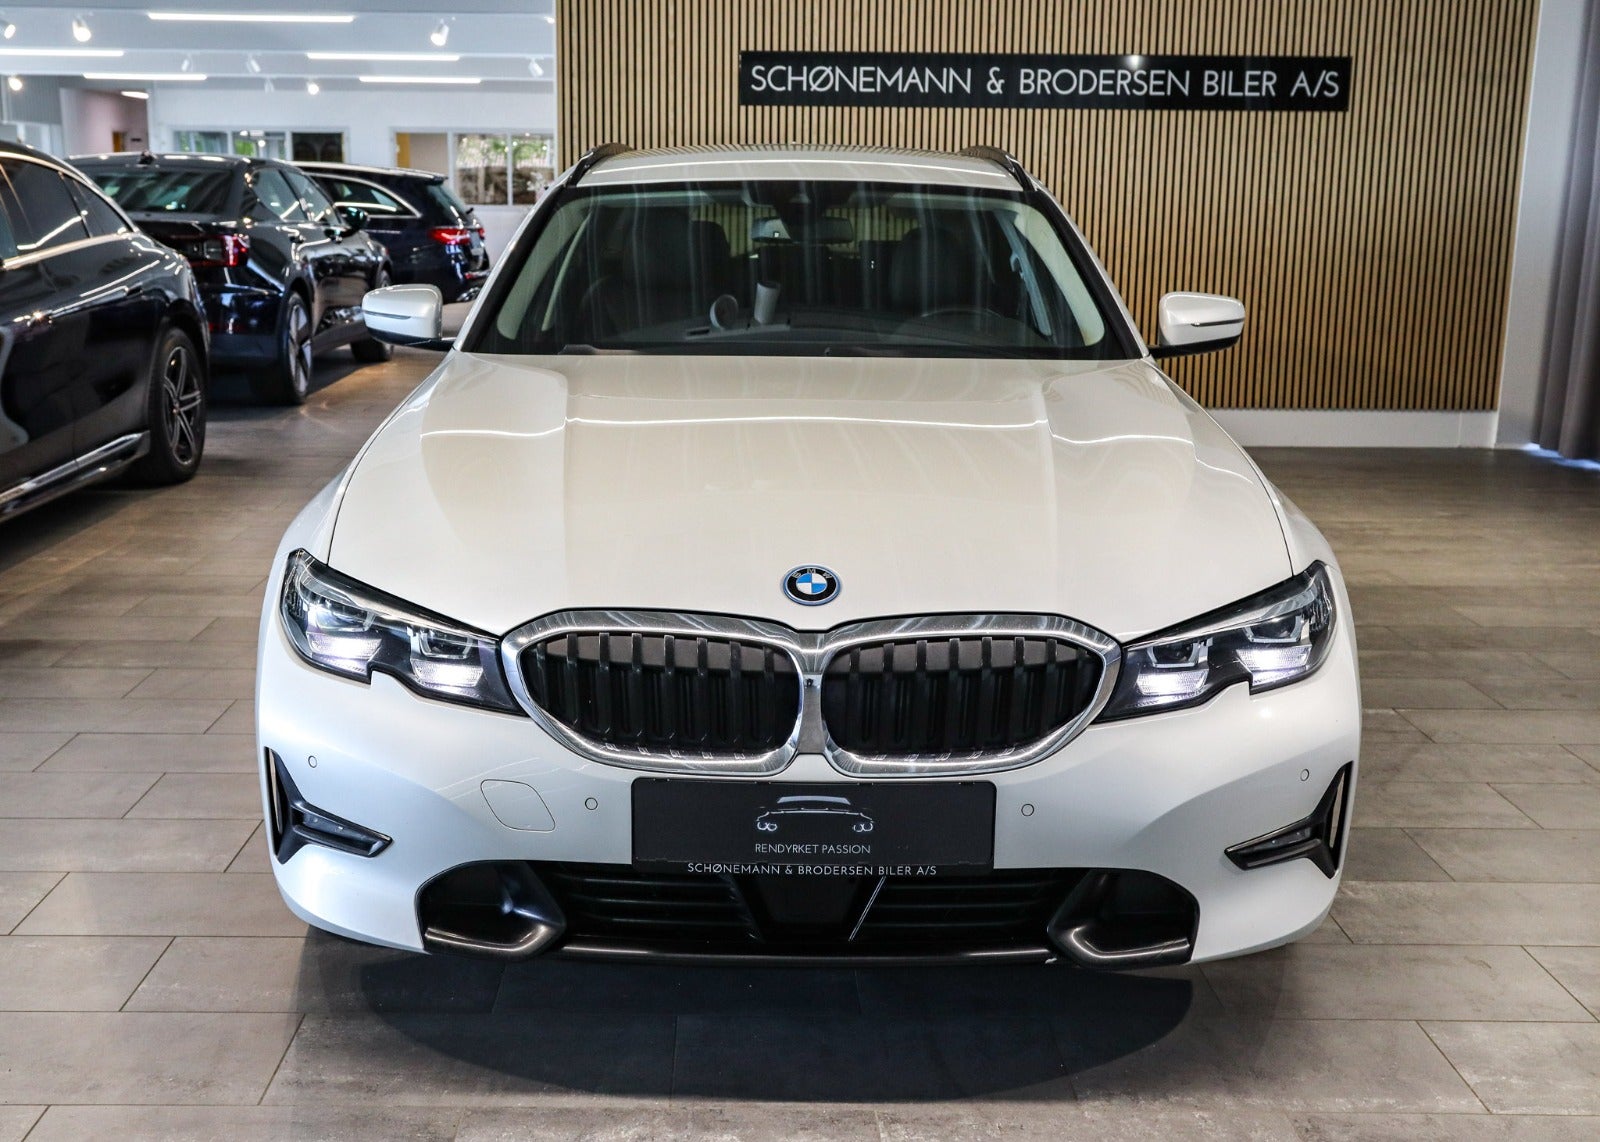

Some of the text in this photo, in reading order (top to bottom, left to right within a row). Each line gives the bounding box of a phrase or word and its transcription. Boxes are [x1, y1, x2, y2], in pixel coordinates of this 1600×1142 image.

[751, 65, 1340, 98] SCHØNEMANN & BRODERSEN BILER A/S
[755, 843, 871, 854] RENDYRKET PASSION
[687, 862, 937, 876] SCHØNEMANN & BRODERSEN BILER A/S
